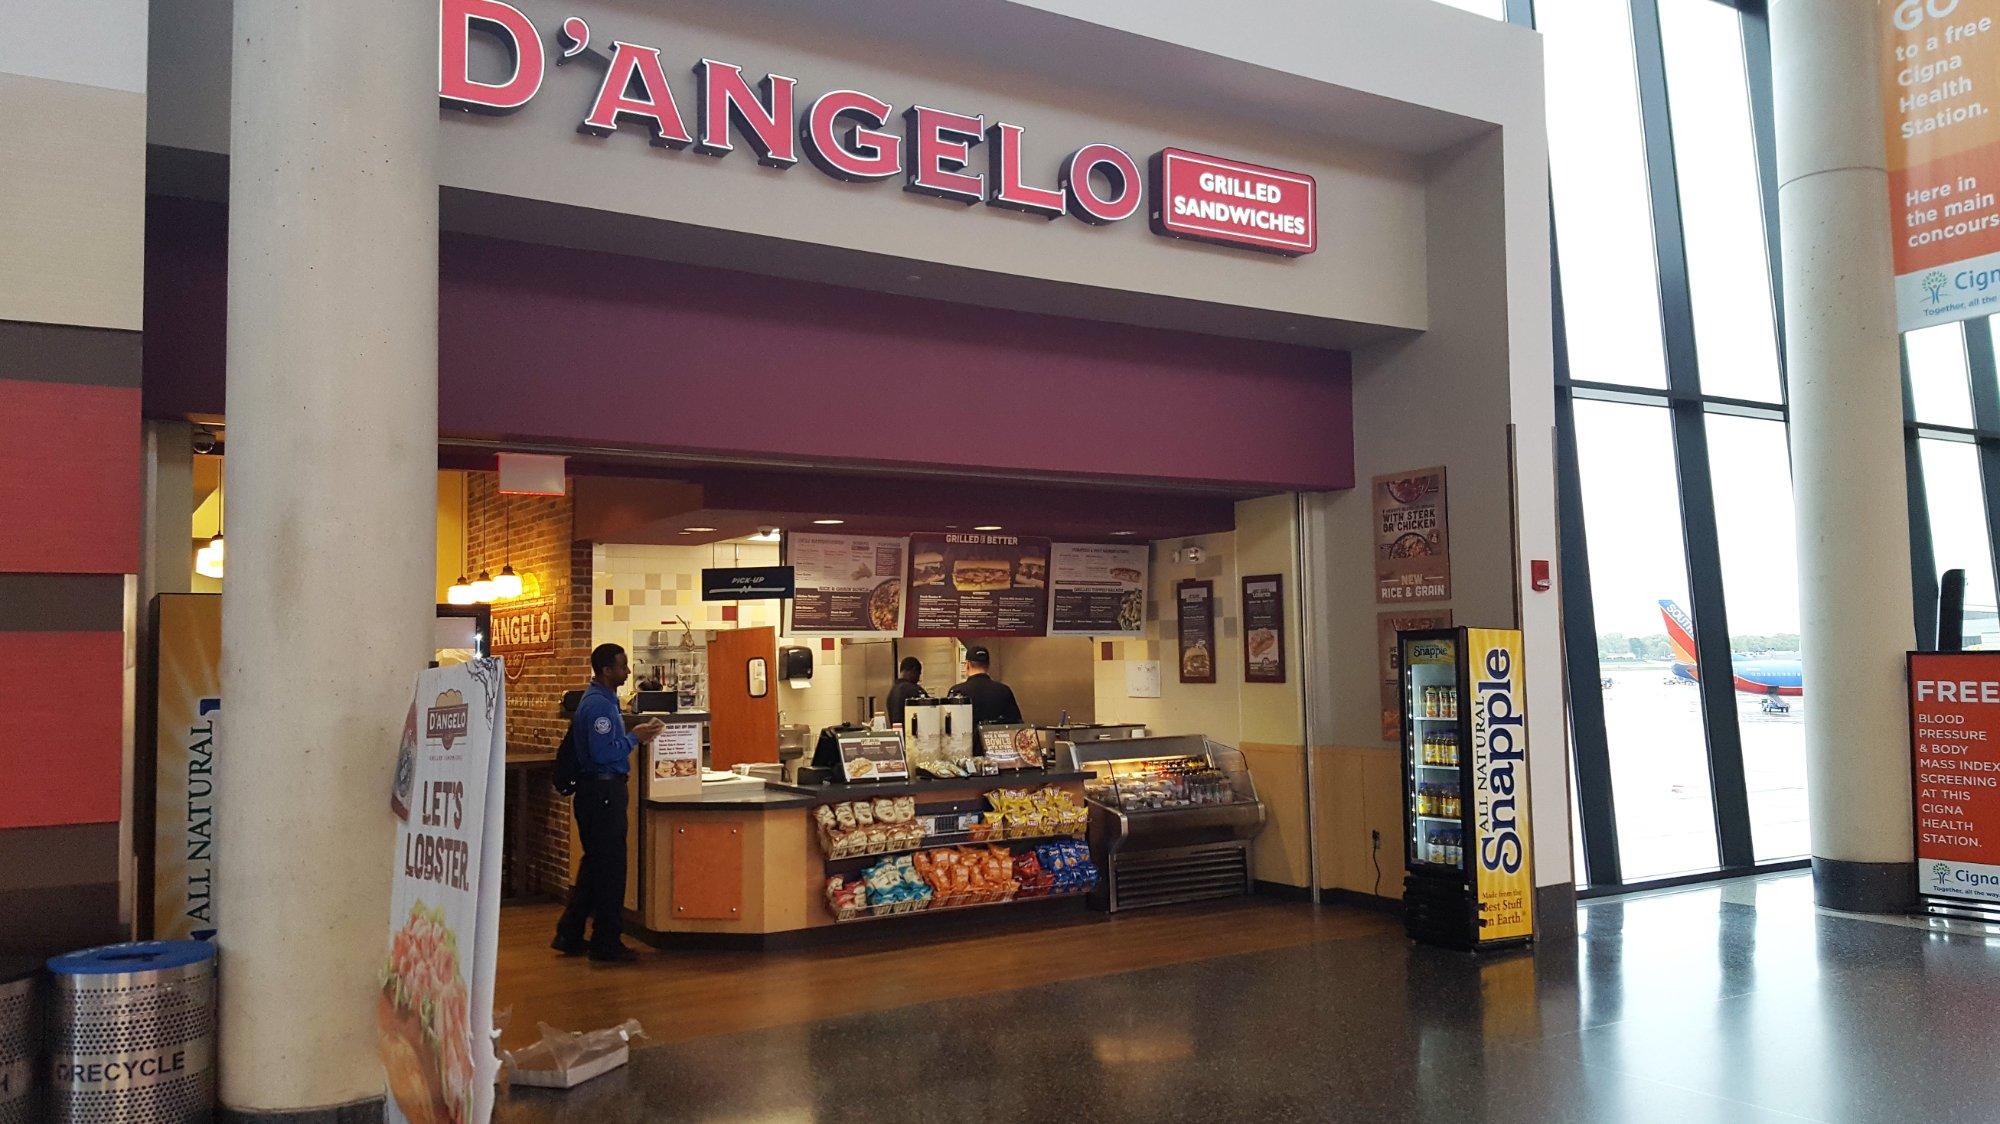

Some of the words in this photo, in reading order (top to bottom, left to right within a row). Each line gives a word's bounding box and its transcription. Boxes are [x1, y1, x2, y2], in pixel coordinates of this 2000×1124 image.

[1895, 44, 1919, 61] to
[1926, 36, 1938, 51] a
[1945, 17, 1992, 44] free
[1898, 55, 1962, 86] Cigna
[1899, 76, 1972, 114] Health
[439, 0, 1142, 222] D'ANGELO
[1901, 102, 1989, 139] Station.
[1199, 172, 1282, 205] GRILLED
[1906, 183, 1952, 208] Here
[1957, 176, 1976, 192] in
[1174, 196, 1306, 236] SANDWICHES
[1906, 208, 1938, 227] the
[1944, 193, 1995, 218] main
[1908, 212, 2000, 248] concours
[1955, 268, 2000, 291] Cign
[1968, 297, 1979, 307] all
[1383, 512, 1404, 523] WITH
[1407, 509, 1436, 520] STEAK
[1383, 523, 1394, 533] OR
[1397, 518, 1436, 531] CHICKEN
[945, 534, 980, 544] GRILLED
[986, 536, 1018, 546] BETTER
[731, 576, 765, 584] PICK-UP
[1401, 573, 1423, 585] NEW
[1381, 587, 1403, 599] RICE
[1405, 586, 1413, 598] &
[1415, 585, 1445, 597] GRAIN
[1667, 604, 1694, 637] SOUTH
[1917, 680, 2000, 703] FREE
[429, 712, 466, 731] D'ANGELO
[1918, 713, 1965, 724] BLOOD
[984, 738, 1012, 746] BOWLS
[1475, 696, 1488, 790] NATURAL
[1919, 729, 1988, 741] PRESSURE
[1920, 744, 1928, 753] &
[1932, 744, 1969, 755] BODY
[1478, 648, 1525, 874] Snapple
[1920, 759, 1956, 769] MASS
[1960, 761, 2000, 772] INDEX
[1920, 773, 1997, 787] SCREENING
[187, 719, 213, 862] NATURAL
[1921, 789, 1937, 799] AT
[1941, 789, 1971, 801] THIS
[422, 781, 464, 830] LET'S
[1478, 796, 1489, 833] ALL
[1922, 803, 1964, 816] CIGNA
[1922, 818, 1974, 832] HEALTH
[1922, 833, 1982, 848] STATION.
[1955, 869, 1999, 886] Cigna
[187, 868, 211, 924] ALL
[1933, 885, 1964, 895] Together,
[1965, 887, 1973, 895] all
[1503, 898, 1522, 911] Stuff
[71, 1050, 186, 1083] RECYCLE
